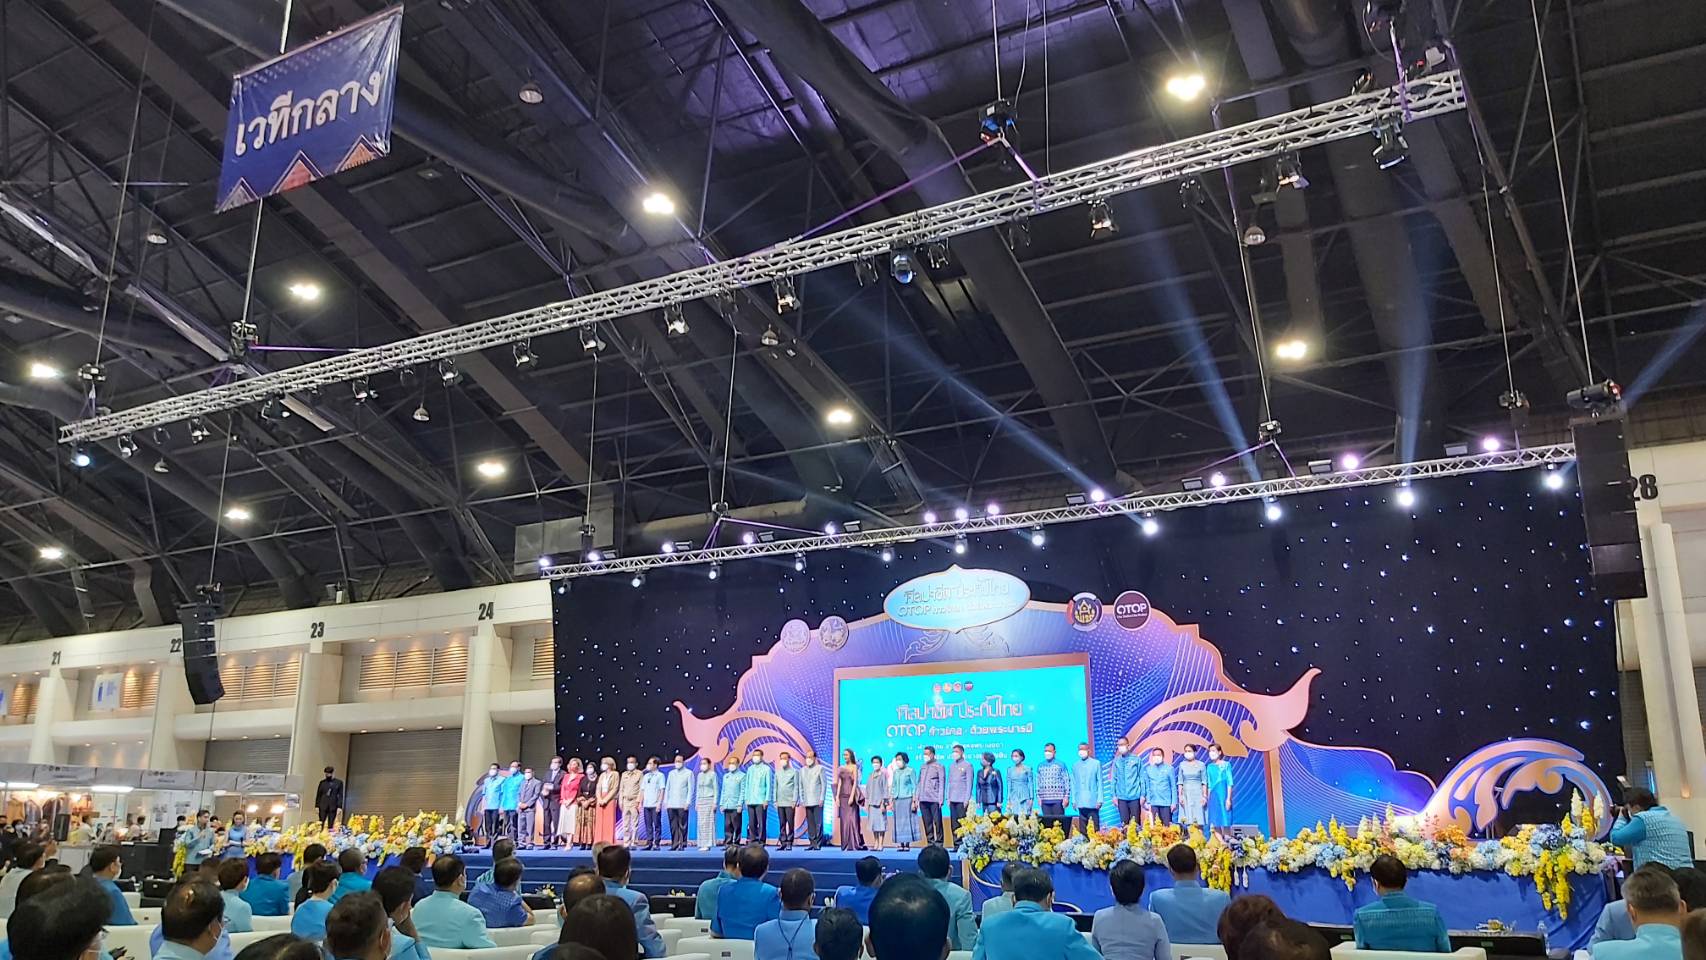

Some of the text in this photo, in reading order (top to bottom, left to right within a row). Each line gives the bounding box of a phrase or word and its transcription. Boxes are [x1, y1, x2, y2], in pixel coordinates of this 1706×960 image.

[235, 71, 382, 156] เวทีกลาง
[478, 602, 494, 620] 24
[1116, 603, 1147, 615] OTOP
[310, 622, 324, 638] 23
[170, 638, 182, 653] 22
[51, 651, 61, 665] 21
[886, 724, 926, 737] OTOP
